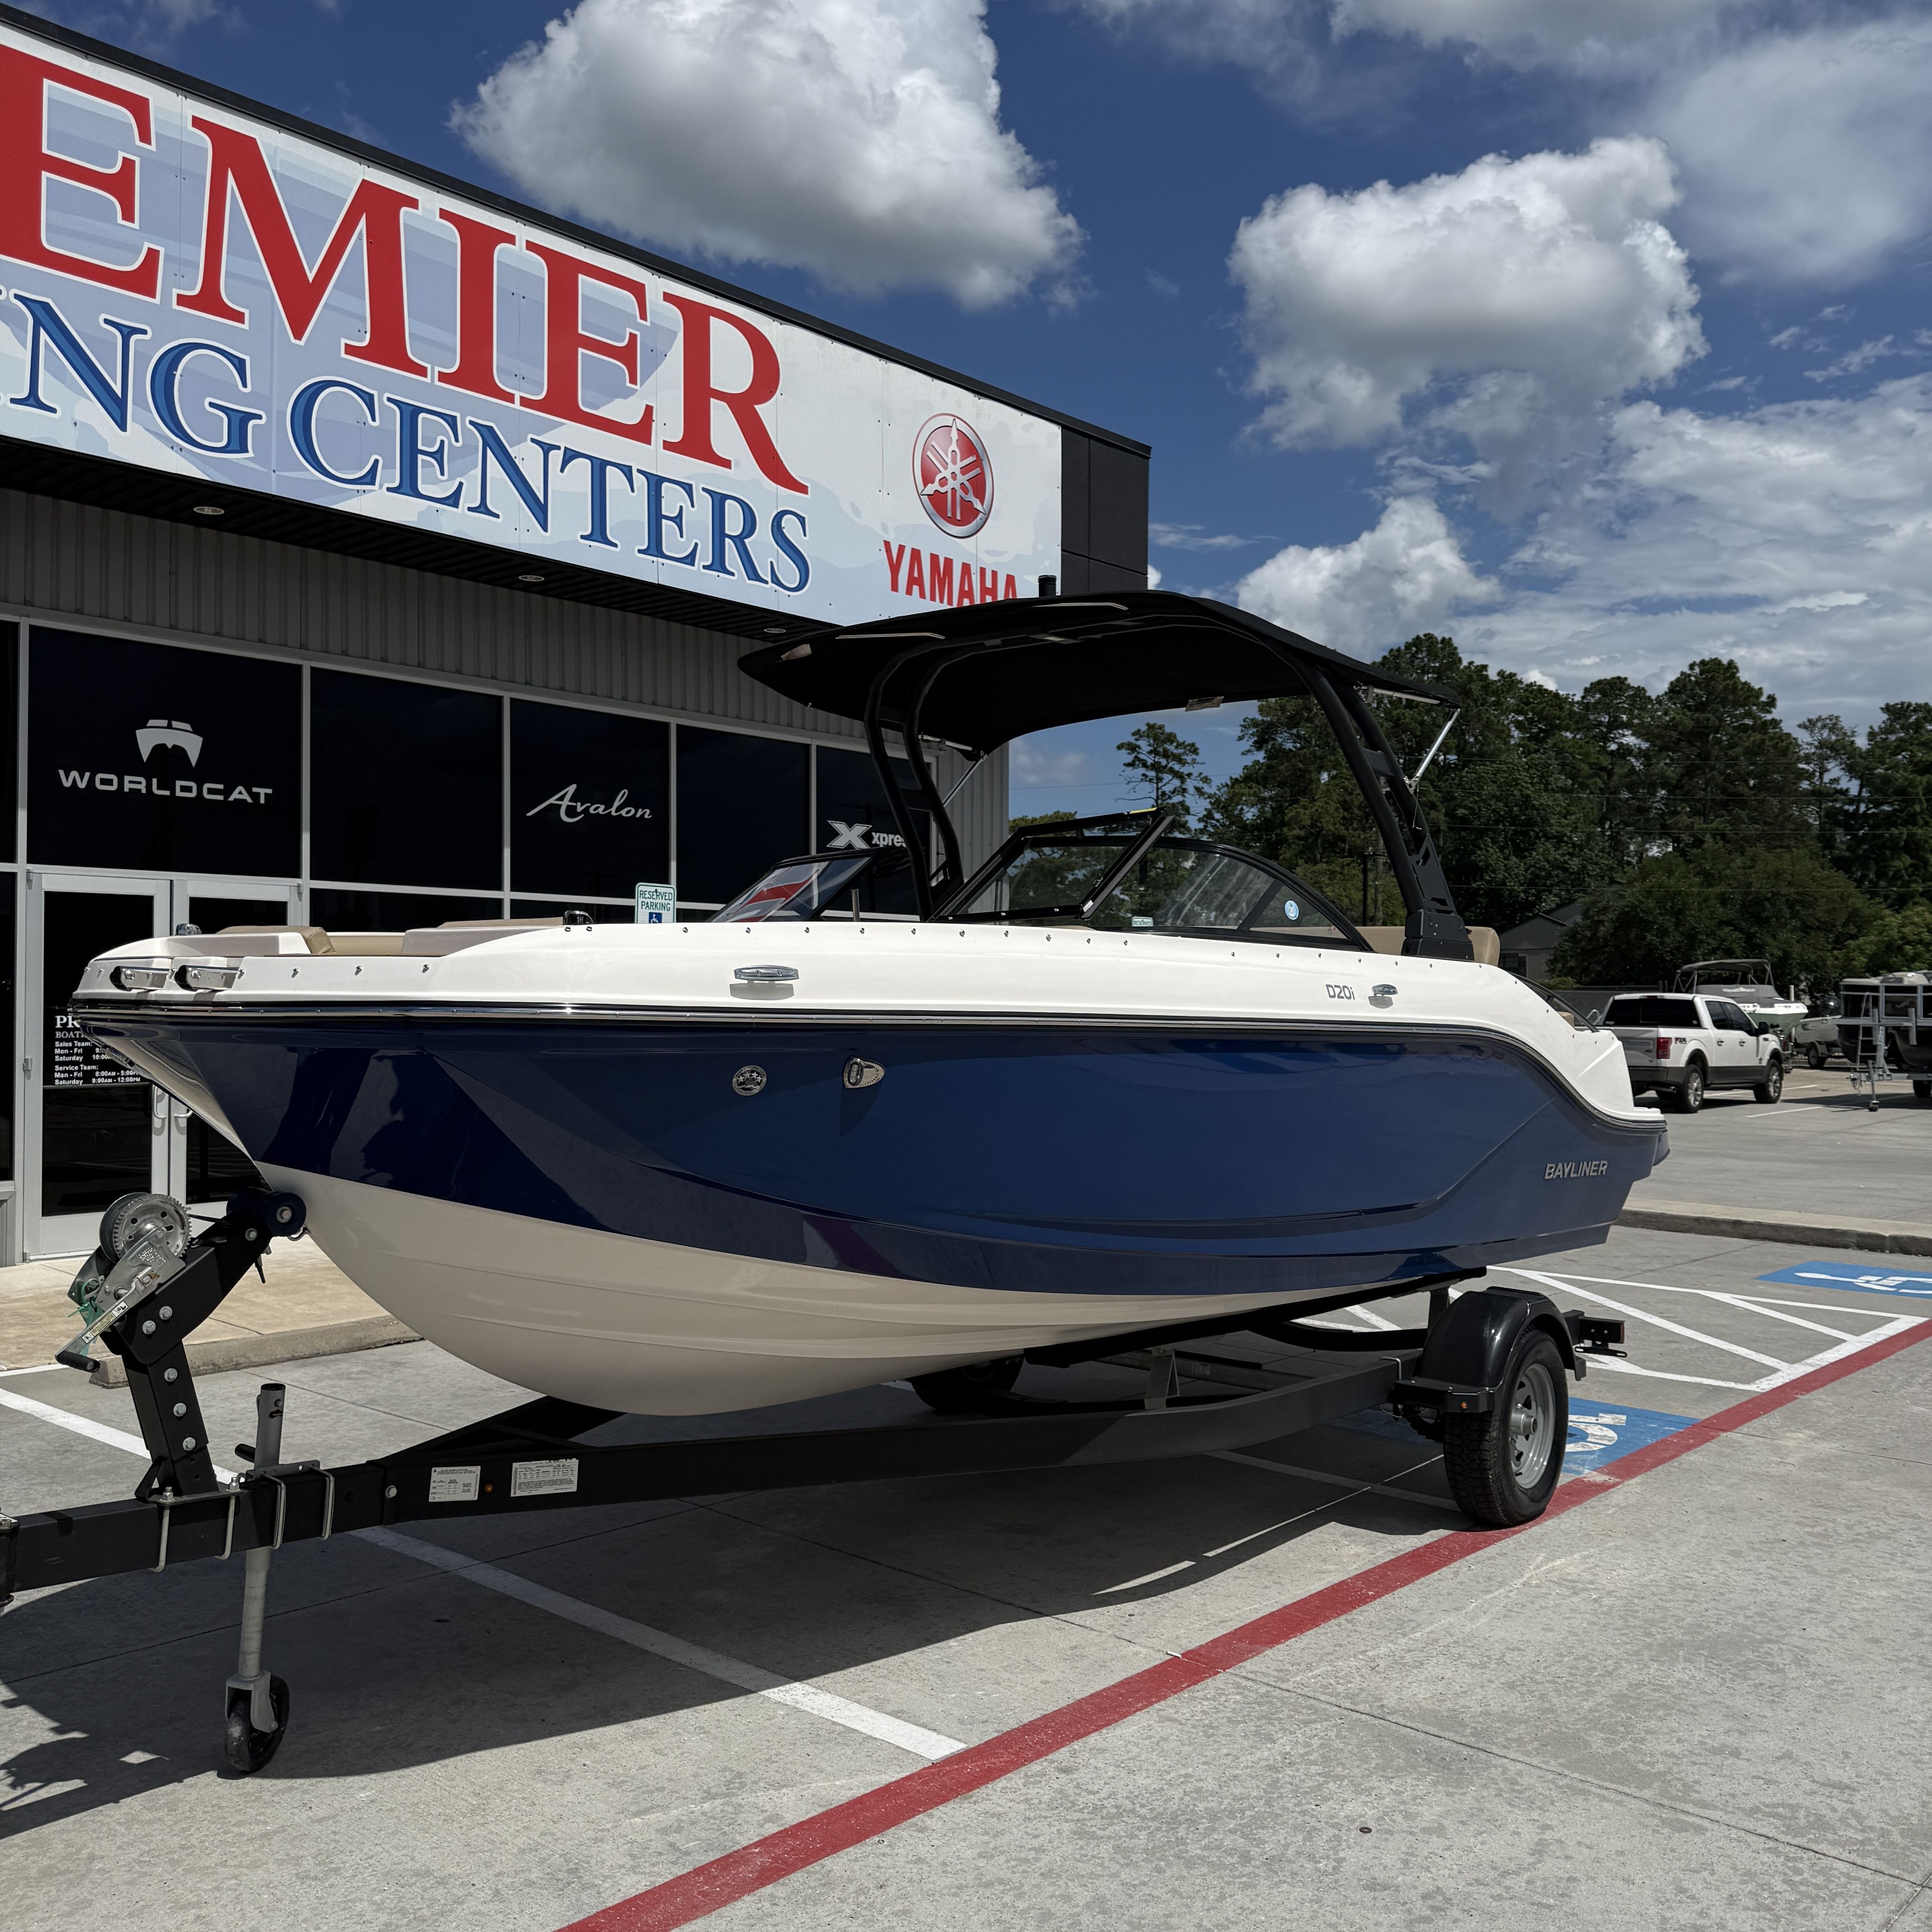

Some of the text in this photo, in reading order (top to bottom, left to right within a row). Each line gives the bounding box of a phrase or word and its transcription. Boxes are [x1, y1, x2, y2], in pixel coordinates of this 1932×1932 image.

[0, 44, 809, 495] EMIER
[0, 289, 810, 592] NG CENTERS
[883, 539, 1017, 607] YAMAHA
[58, 769, 273, 804] WORLDCAT
[525, 783, 653, 823] Avalon
[871, 832, 907, 848] xpres
[639, 890, 673, 901] RESERVED
[641, 901, 671, 911] PARKING
[1325, 984, 1355, 1000] D20i
[55, 1015, 81, 1028] PR
[1544, 1160, 1608, 1179] BAYLINER
